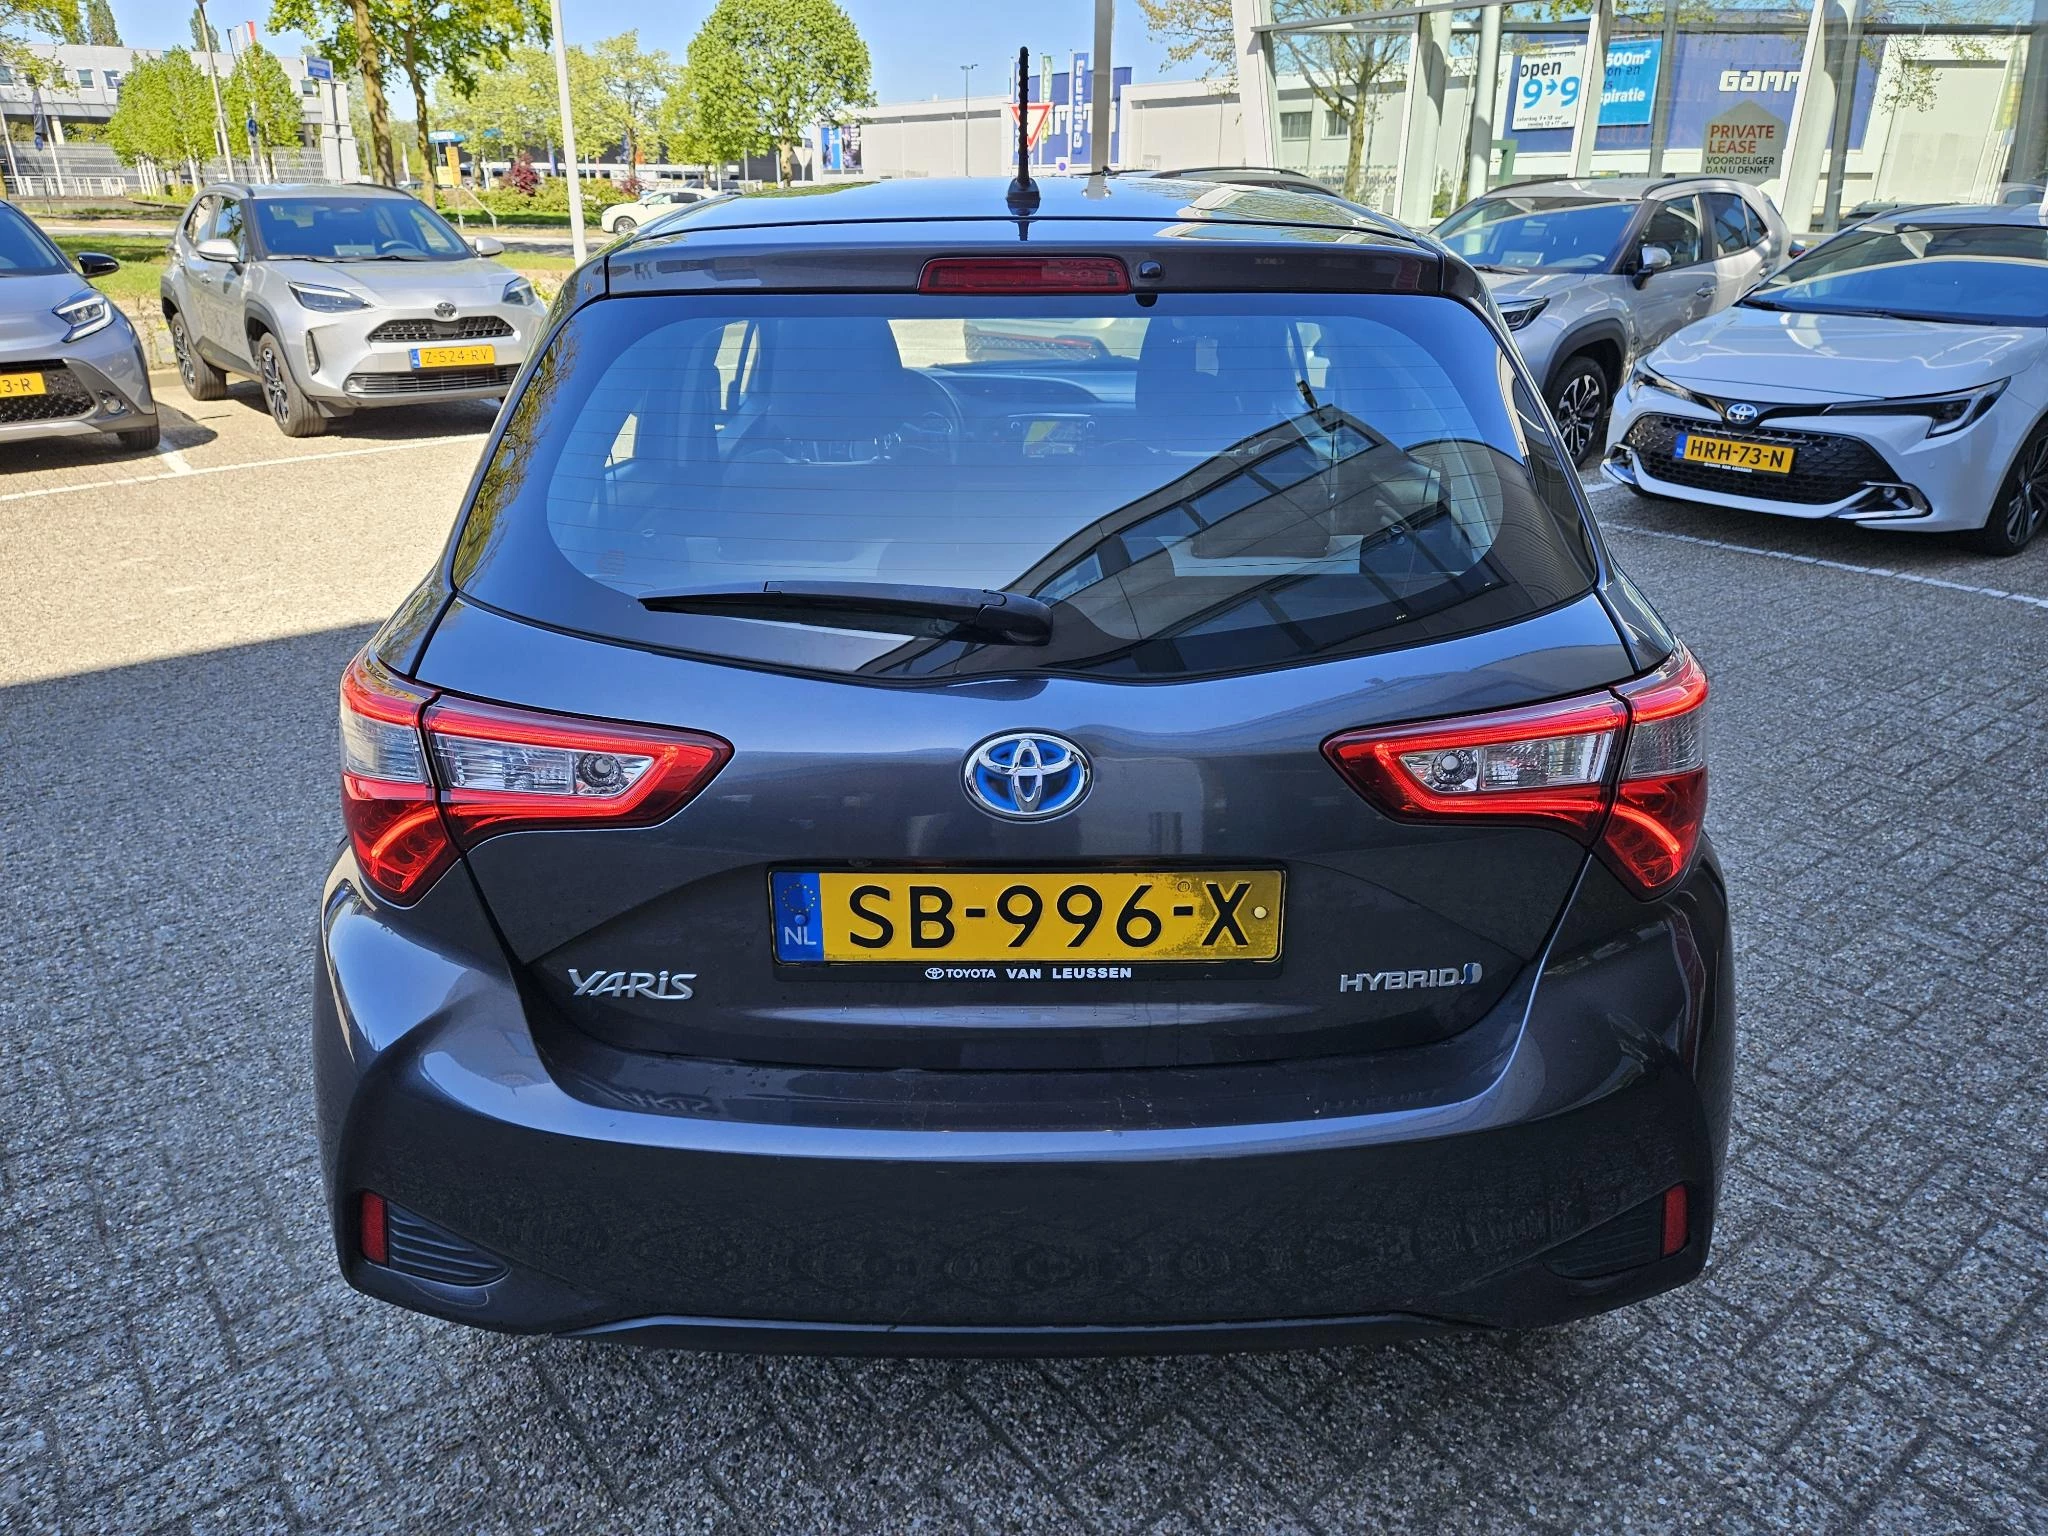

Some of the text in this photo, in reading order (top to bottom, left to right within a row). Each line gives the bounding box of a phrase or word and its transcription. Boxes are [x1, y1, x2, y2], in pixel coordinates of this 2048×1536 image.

[1520, 61, 1562, 79] open
[1523, 76, 1580, 110] 9 9
[1710, 125, 1775, 139] PRIVATE
[1708, 140, 1757, 154] LEASE
[1706, 156, 1775, 165] VOORDELIGER
[1705, 165, 1770, 175] DAN U DENKT
[1690, 439, 1785, 468] HRH-73-N
[784, 881, 1251, 949] NL SB-996-X
[946, 967, 1132, 979] TOYOTA VAN LEUSSEN
[1340, 967, 1460, 993] HYBRID
